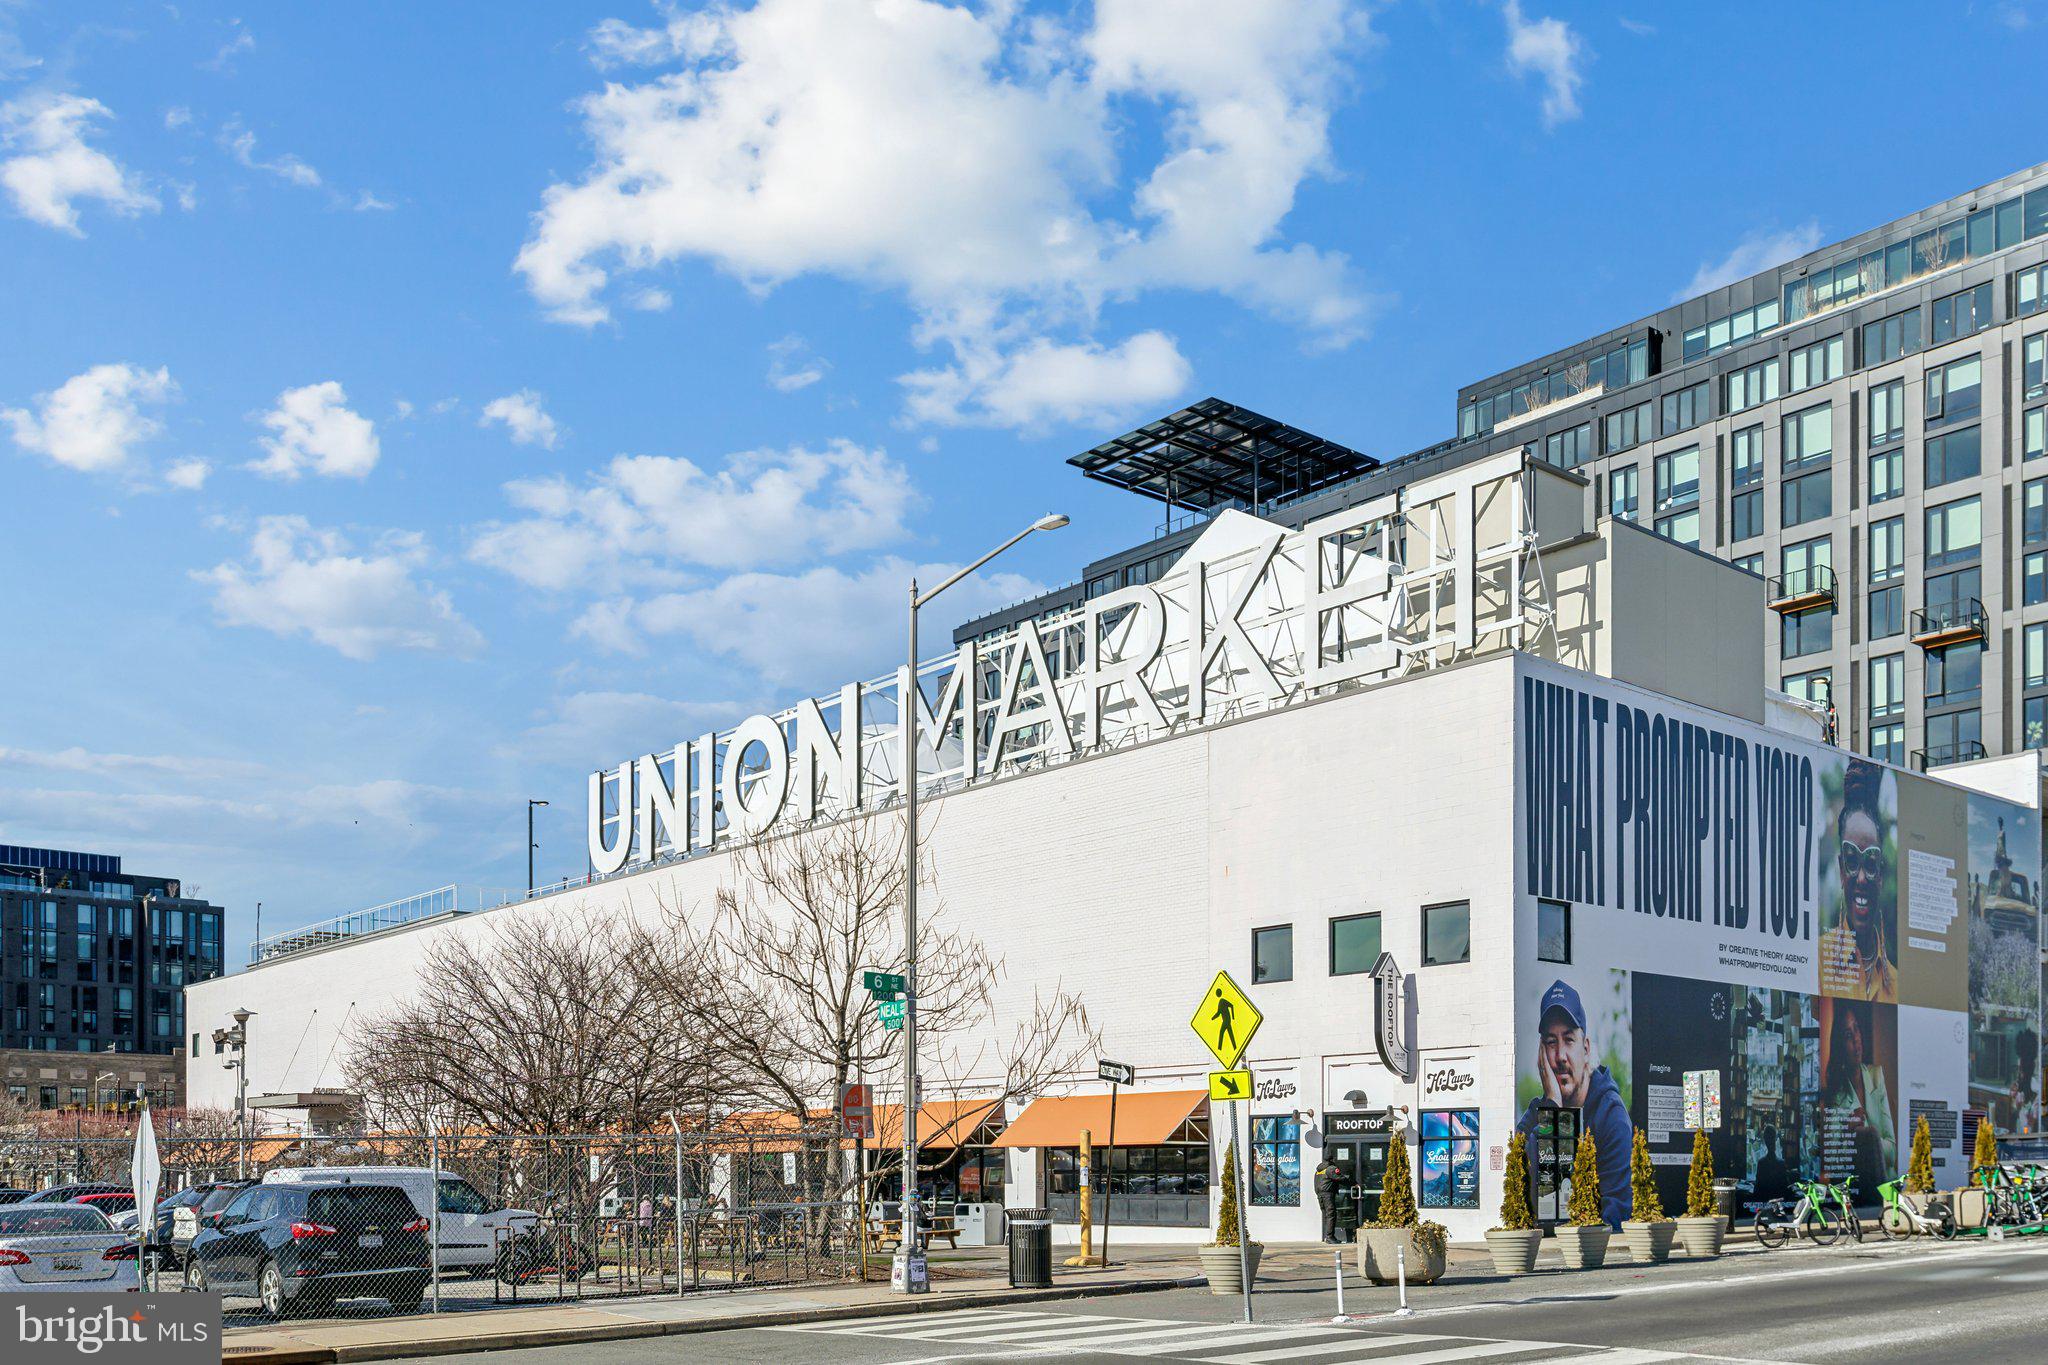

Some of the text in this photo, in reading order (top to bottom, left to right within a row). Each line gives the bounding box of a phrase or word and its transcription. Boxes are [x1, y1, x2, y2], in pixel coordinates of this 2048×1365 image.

[588, 448, 1523, 875] UNION MARKET
[1523, 675, 1813, 940] WHAT PROMPTED YOU?
[1719, 943, 1808, 964] BY CREATIVE THEORY AGENCY
[1719, 956, 1797, 975] WHATPROMPTEDYOU.COM
[874, 975, 883, 989] 6
[881, 1004, 900, 1018] NEAL
[887, 1018, 901, 1028] 500
[1101, 1066, 1112, 1076] ONE
[1649, 1063, 1672, 1073] /imagine
[1257, 1078, 1297, 1101] Hi-Lawn
[1427, 1069, 1474, 1094] Hi-Lawn
[1336, 1120, 1383, 1130] ROOFTOP
